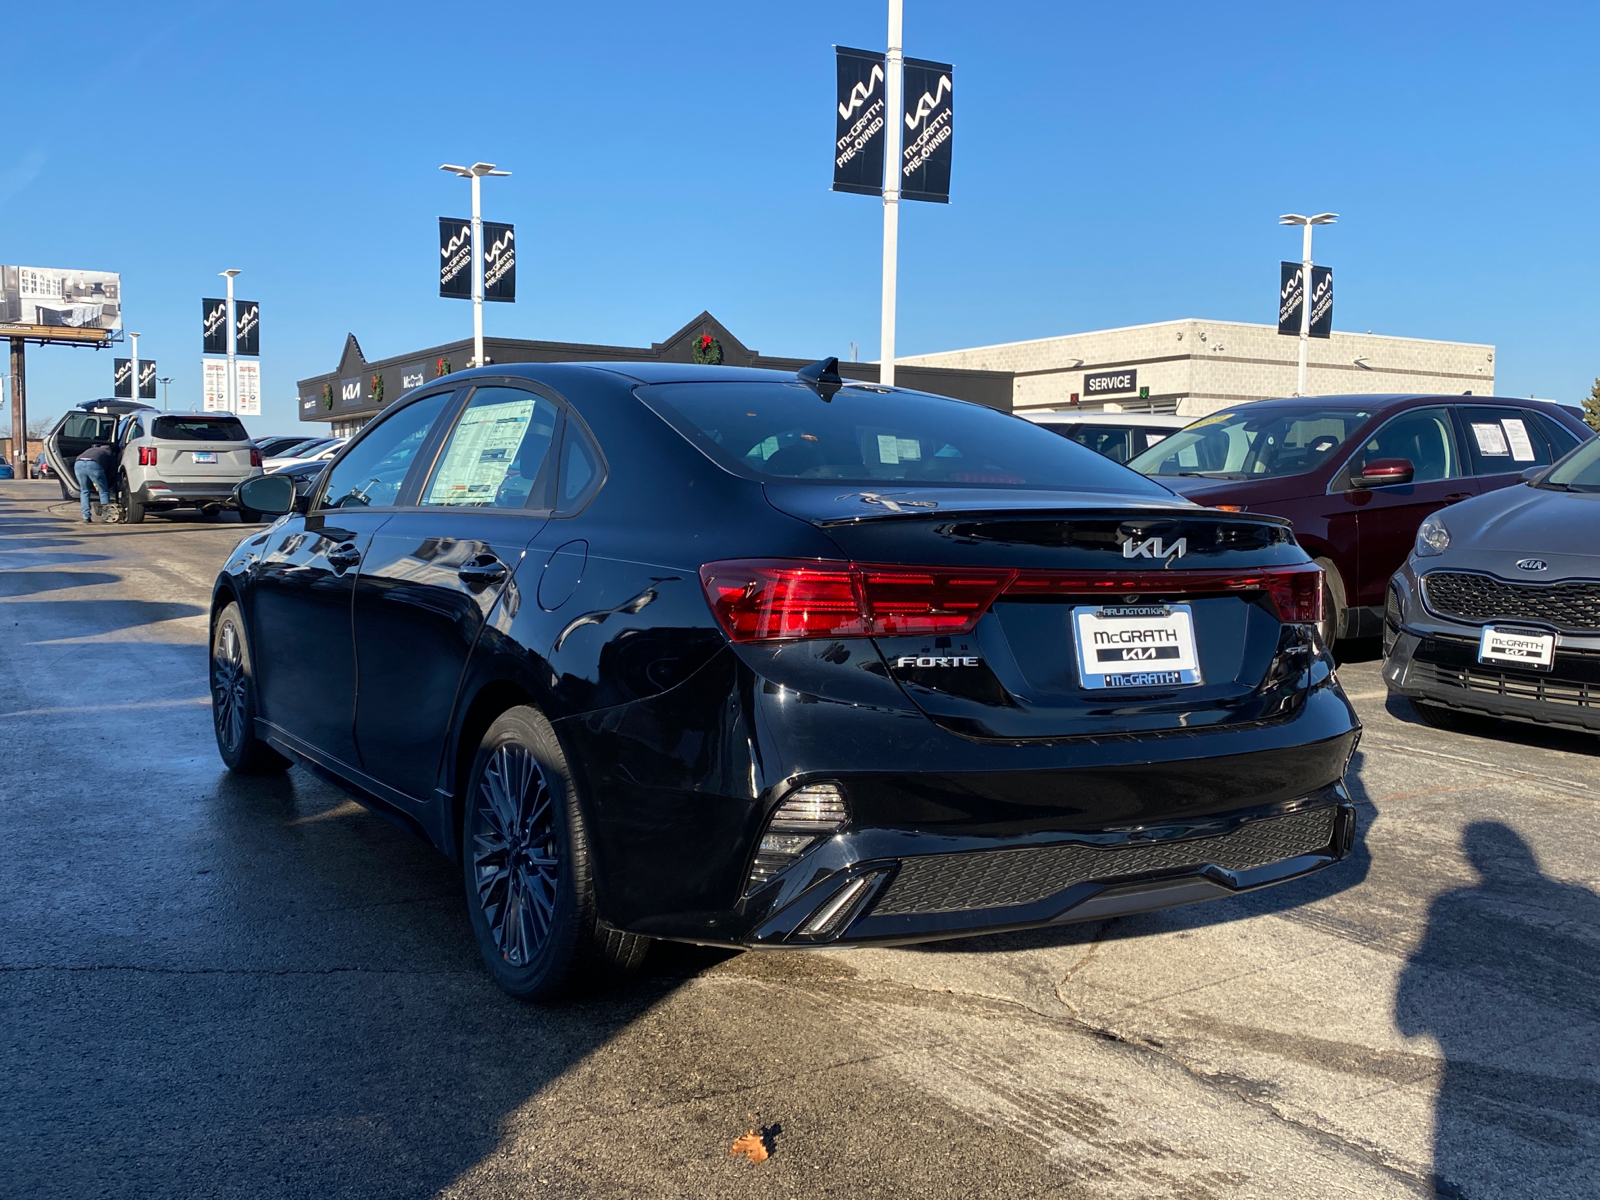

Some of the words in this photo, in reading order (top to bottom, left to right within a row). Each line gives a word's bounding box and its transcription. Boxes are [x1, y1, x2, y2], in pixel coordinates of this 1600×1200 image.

[838, 64, 884, 120] KIA
[905, 75, 952, 130] KIA
[837, 98, 884, 150] McGRATH
[903, 108, 952, 159] McGRATH
[836, 117, 884, 168] PRE-OWNED
[903, 125, 951, 177] PRE-OWNED
[441, 226, 471, 258] KIA
[484, 230, 514, 263] KIA
[440, 255, 471, 285] PRE-OWNED
[484, 259, 515, 289] PRE-OWNED
[1281, 269, 1302, 299] KIA
[1312, 273, 1332, 302] KIA
[342, 382, 361, 401] KIA
[1089, 375, 1130, 391] SERVICE
[1123, 537, 1187, 558] KIA
[1520, 561, 1542, 569] KIA
[1103, 607, 1151, 616] ARLINGTON
[1150, 607, 1165, 616] KIA
[1094, 629, 1178, 644] McGRATH
[1492, 638, 1544, 650] McGRATH
[897, 656, 979, 668] FORTE
[1122, 648, 1157, 660] KIA
[1505, 648, 1527, 656] KIA
[1111, 672, 1176, 686] McGRATH
